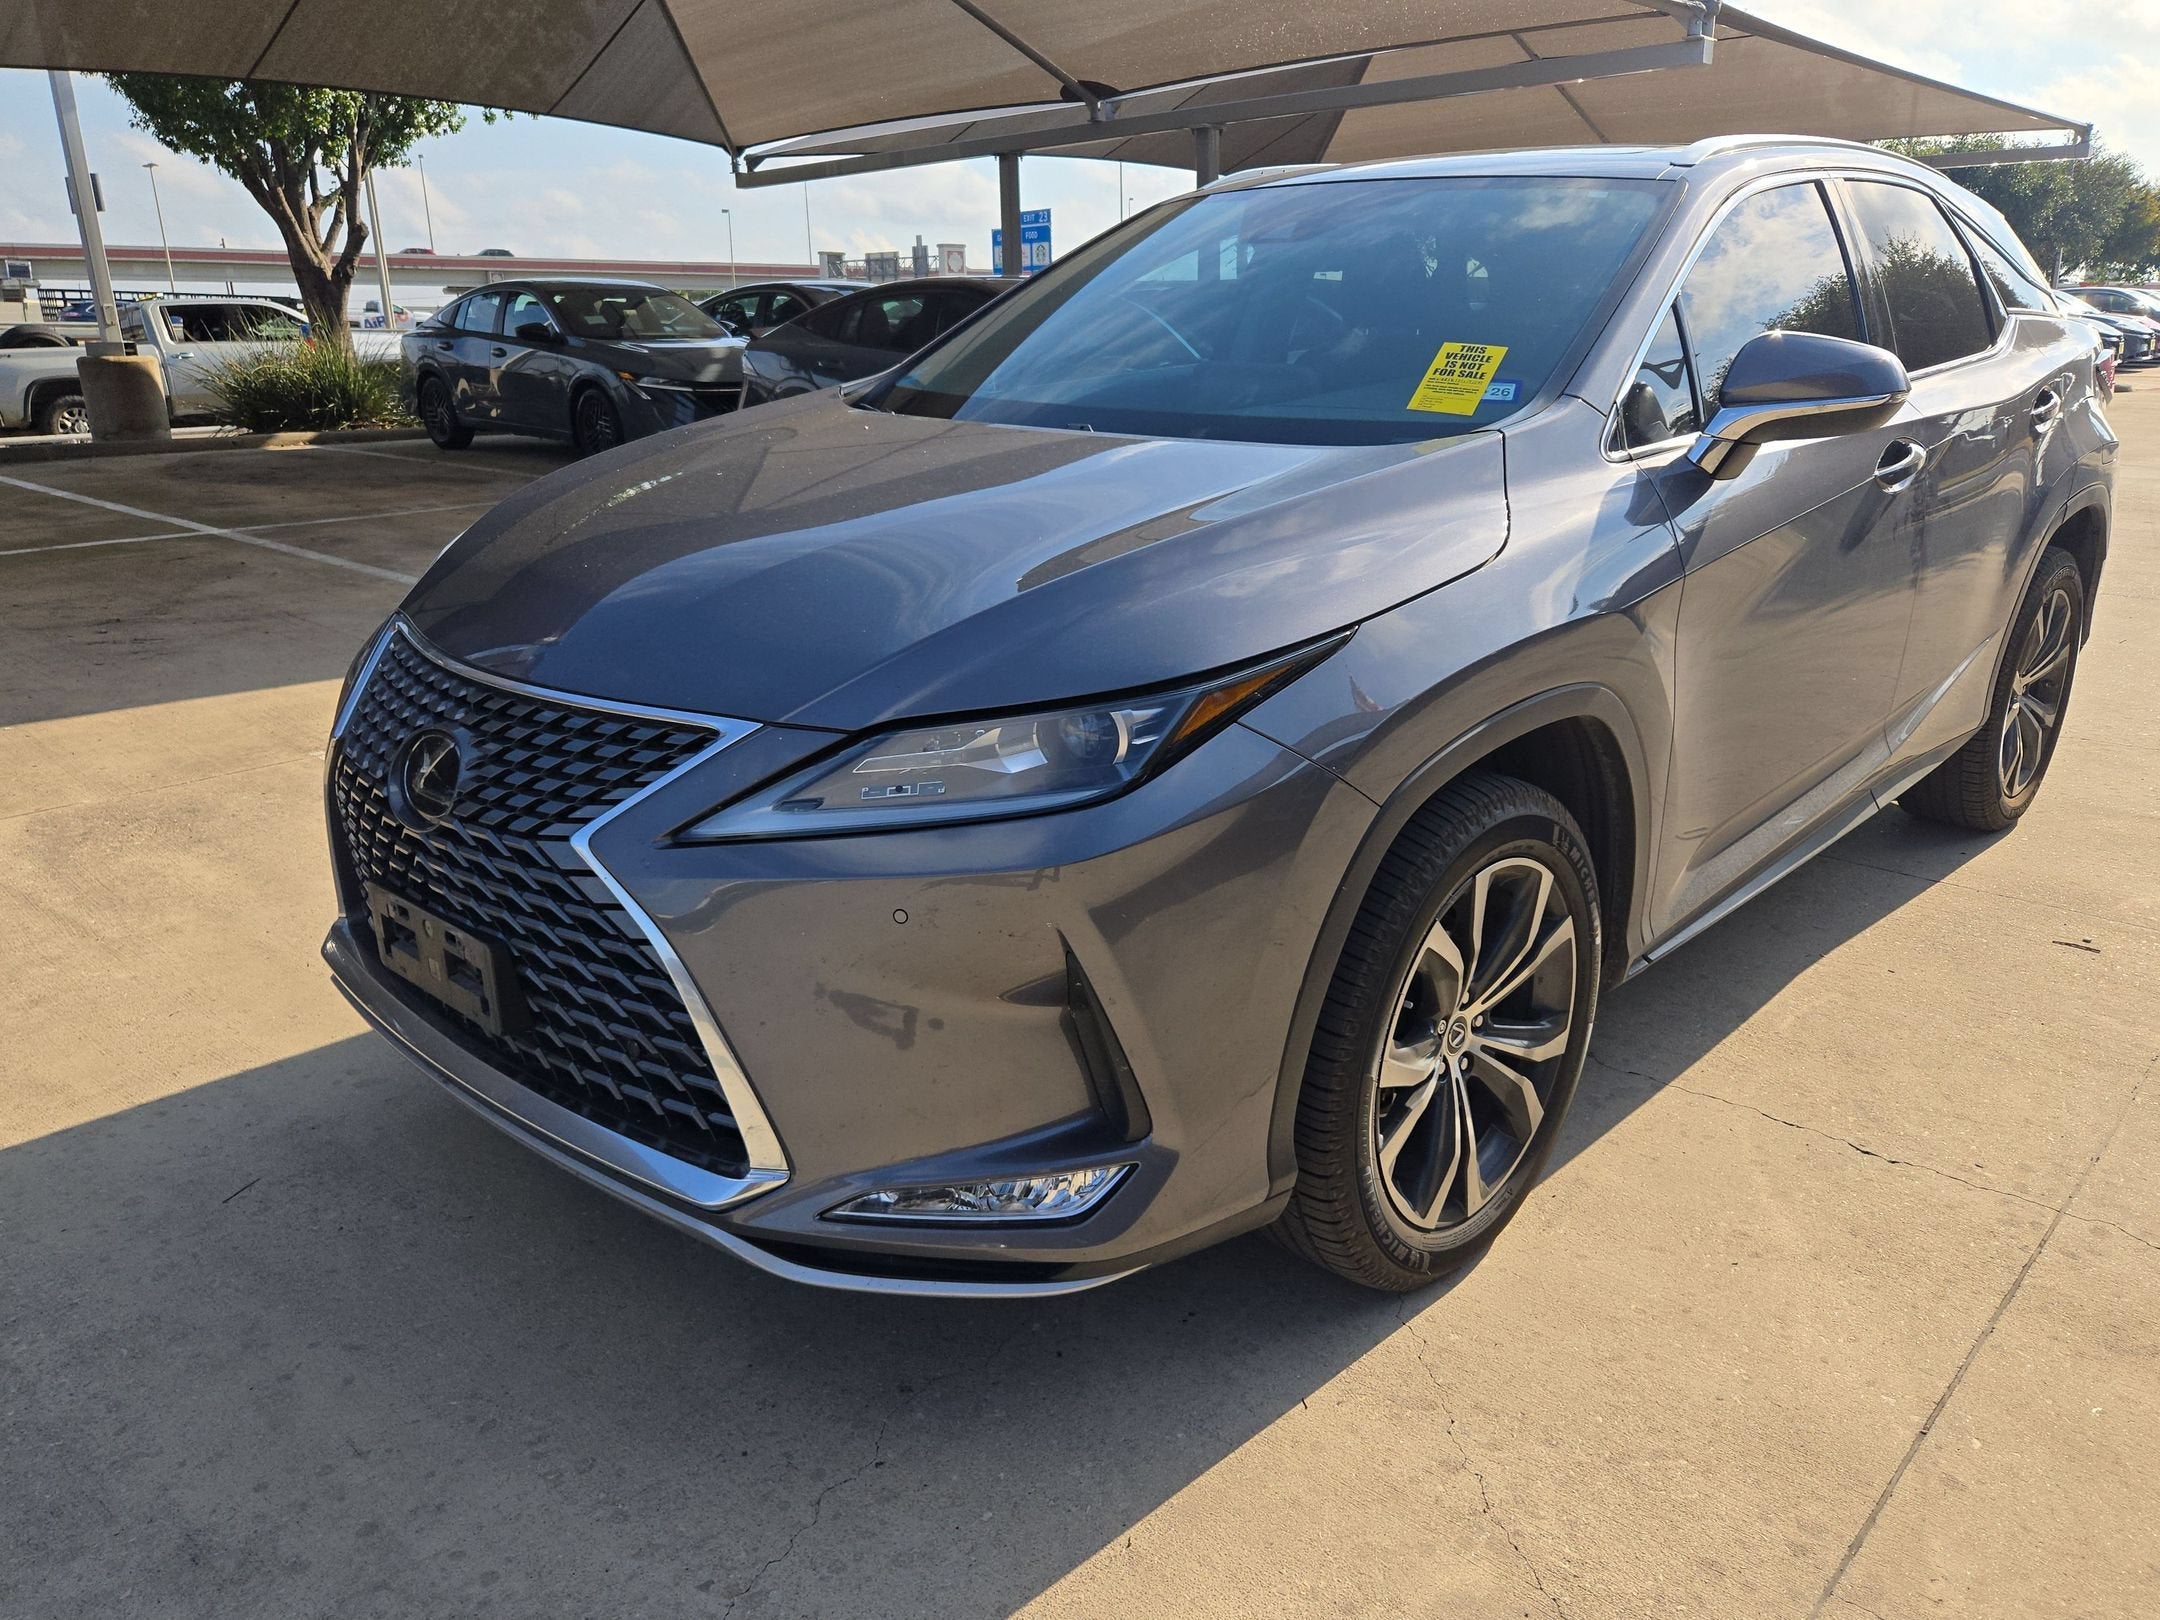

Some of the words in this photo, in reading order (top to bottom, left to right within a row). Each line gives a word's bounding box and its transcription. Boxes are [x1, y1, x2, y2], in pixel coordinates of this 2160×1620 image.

[1039, 211, 1048, 222] 23
[1025, 231, 1038, 240] FOOD
[1460, 345, 1487, 354] THIS
[1445, 352, 1493, 363] VEHICLE
[1459, 361, 1484, 371] NOT
[1433, 368, 1455, 377] FOR
[1458, 370, 1487, 380] SALE
[1490, 387, 1511, 397] 26
